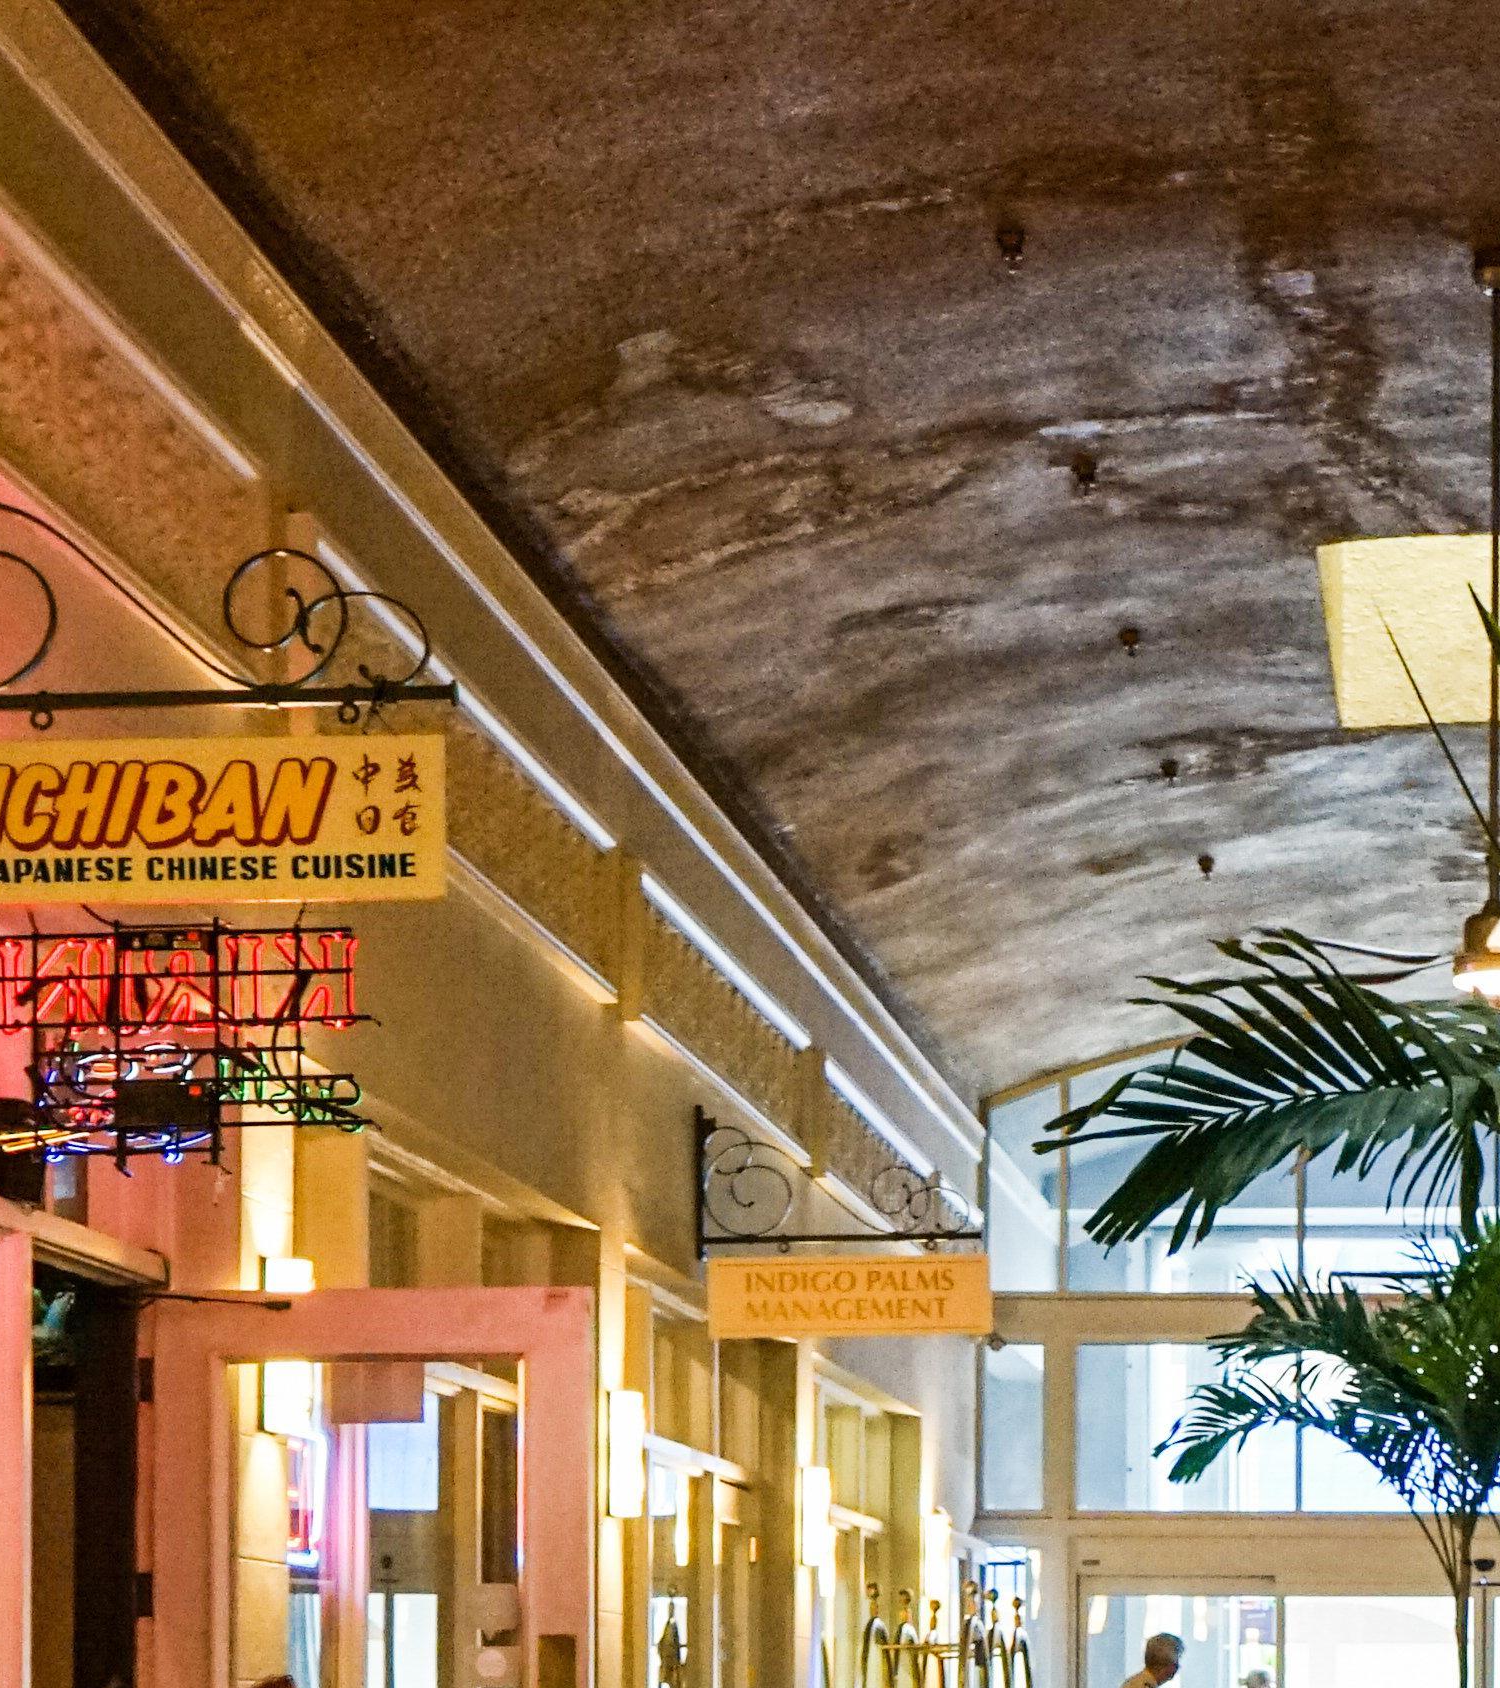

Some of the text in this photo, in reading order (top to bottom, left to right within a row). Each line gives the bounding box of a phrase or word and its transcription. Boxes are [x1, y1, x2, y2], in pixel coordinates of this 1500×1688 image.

[147, 854, 277, 882] CHINESE
[292, 852, 417, 878] CUISINE
[744, 1269, 954, 1293] INDIGO PALMS
[744, 1297, 947, 1322] MANAGEMENT
